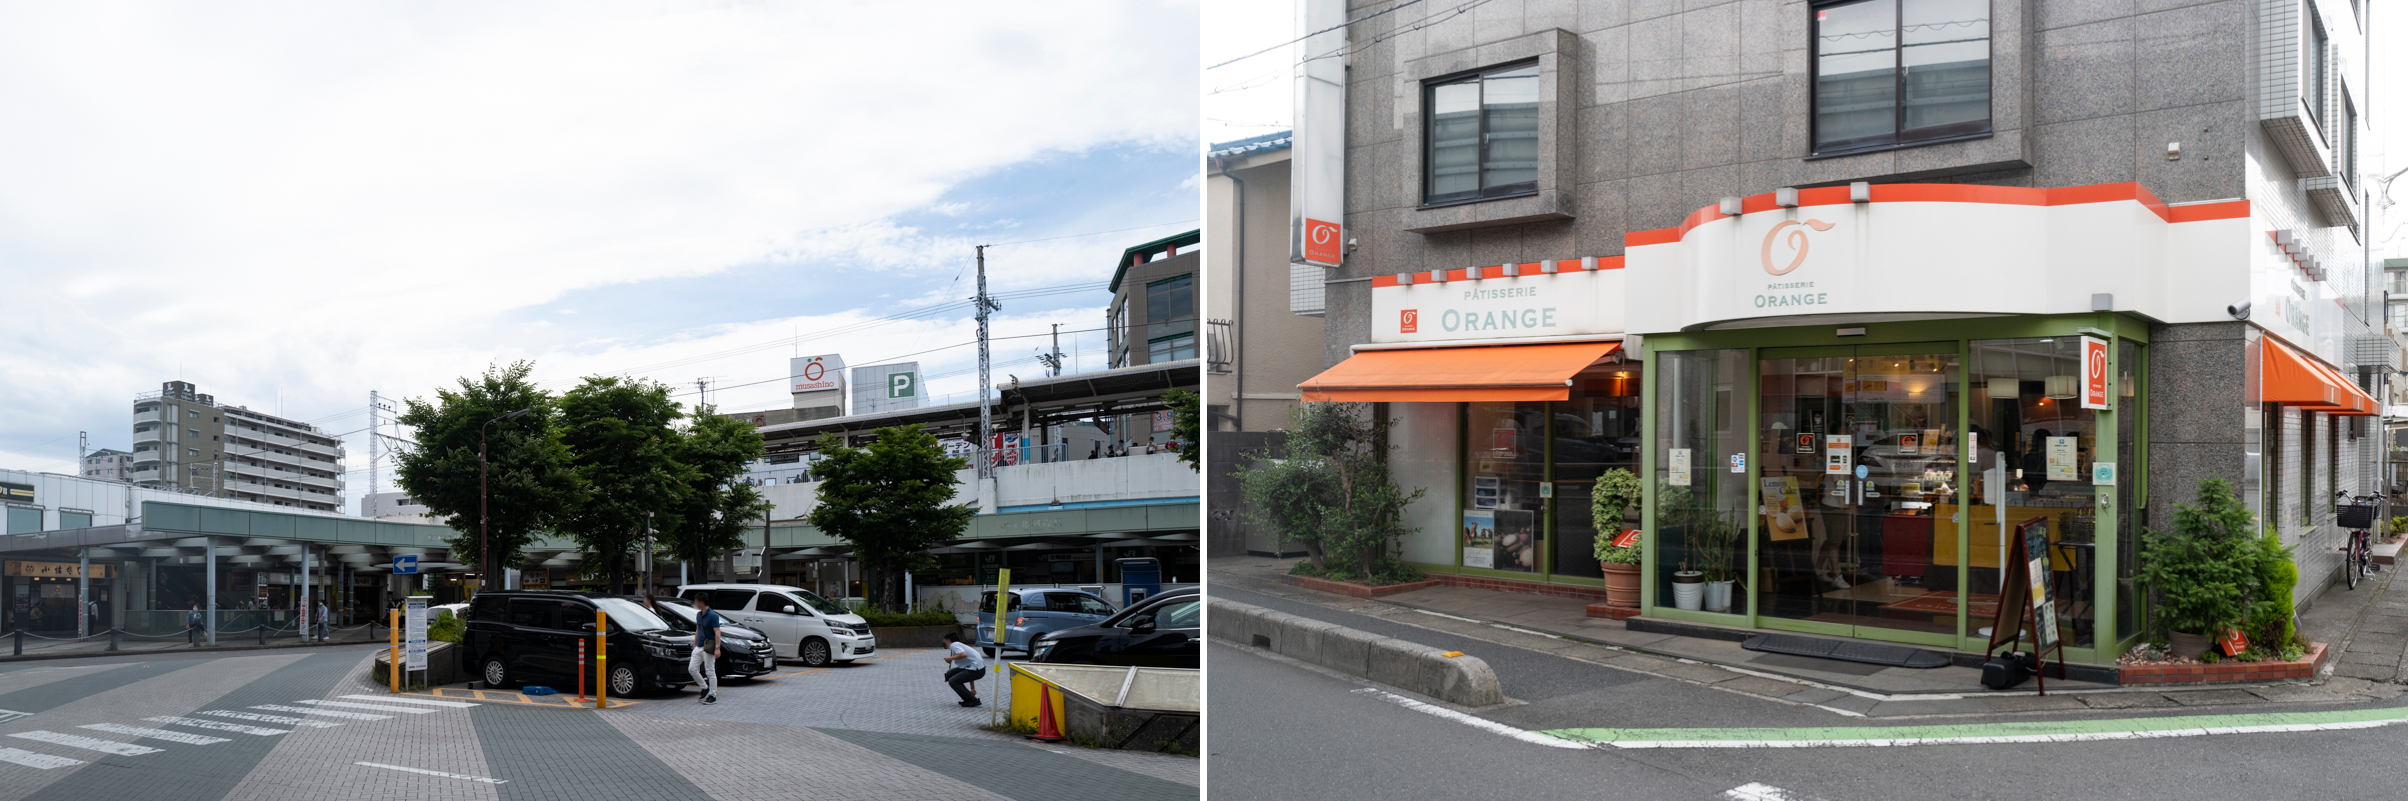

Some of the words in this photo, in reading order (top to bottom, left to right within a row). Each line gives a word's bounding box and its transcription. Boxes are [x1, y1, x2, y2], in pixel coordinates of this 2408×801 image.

[1308, 249, 1336, 259] ORANGE
[1767, 281, 1815, 290] PÂTISSERIE
[1464, 286, 1537, 301] PÂTISSERIE
[1754, 292, 1828, 308] ORANGE
[1441, 307, 1557, 332] ORANGE
[2285, 295, 2310, 337] ORANGE
[795, 380, 835, 390] musashino
[893, 374, 910, 397] P
[1763, 479, 1787, 488] Lemon
[1779, 486, 1798, 495] Cake
[1123, 549, 1136, 557] JR
[985, 554, 996, 563] JR
